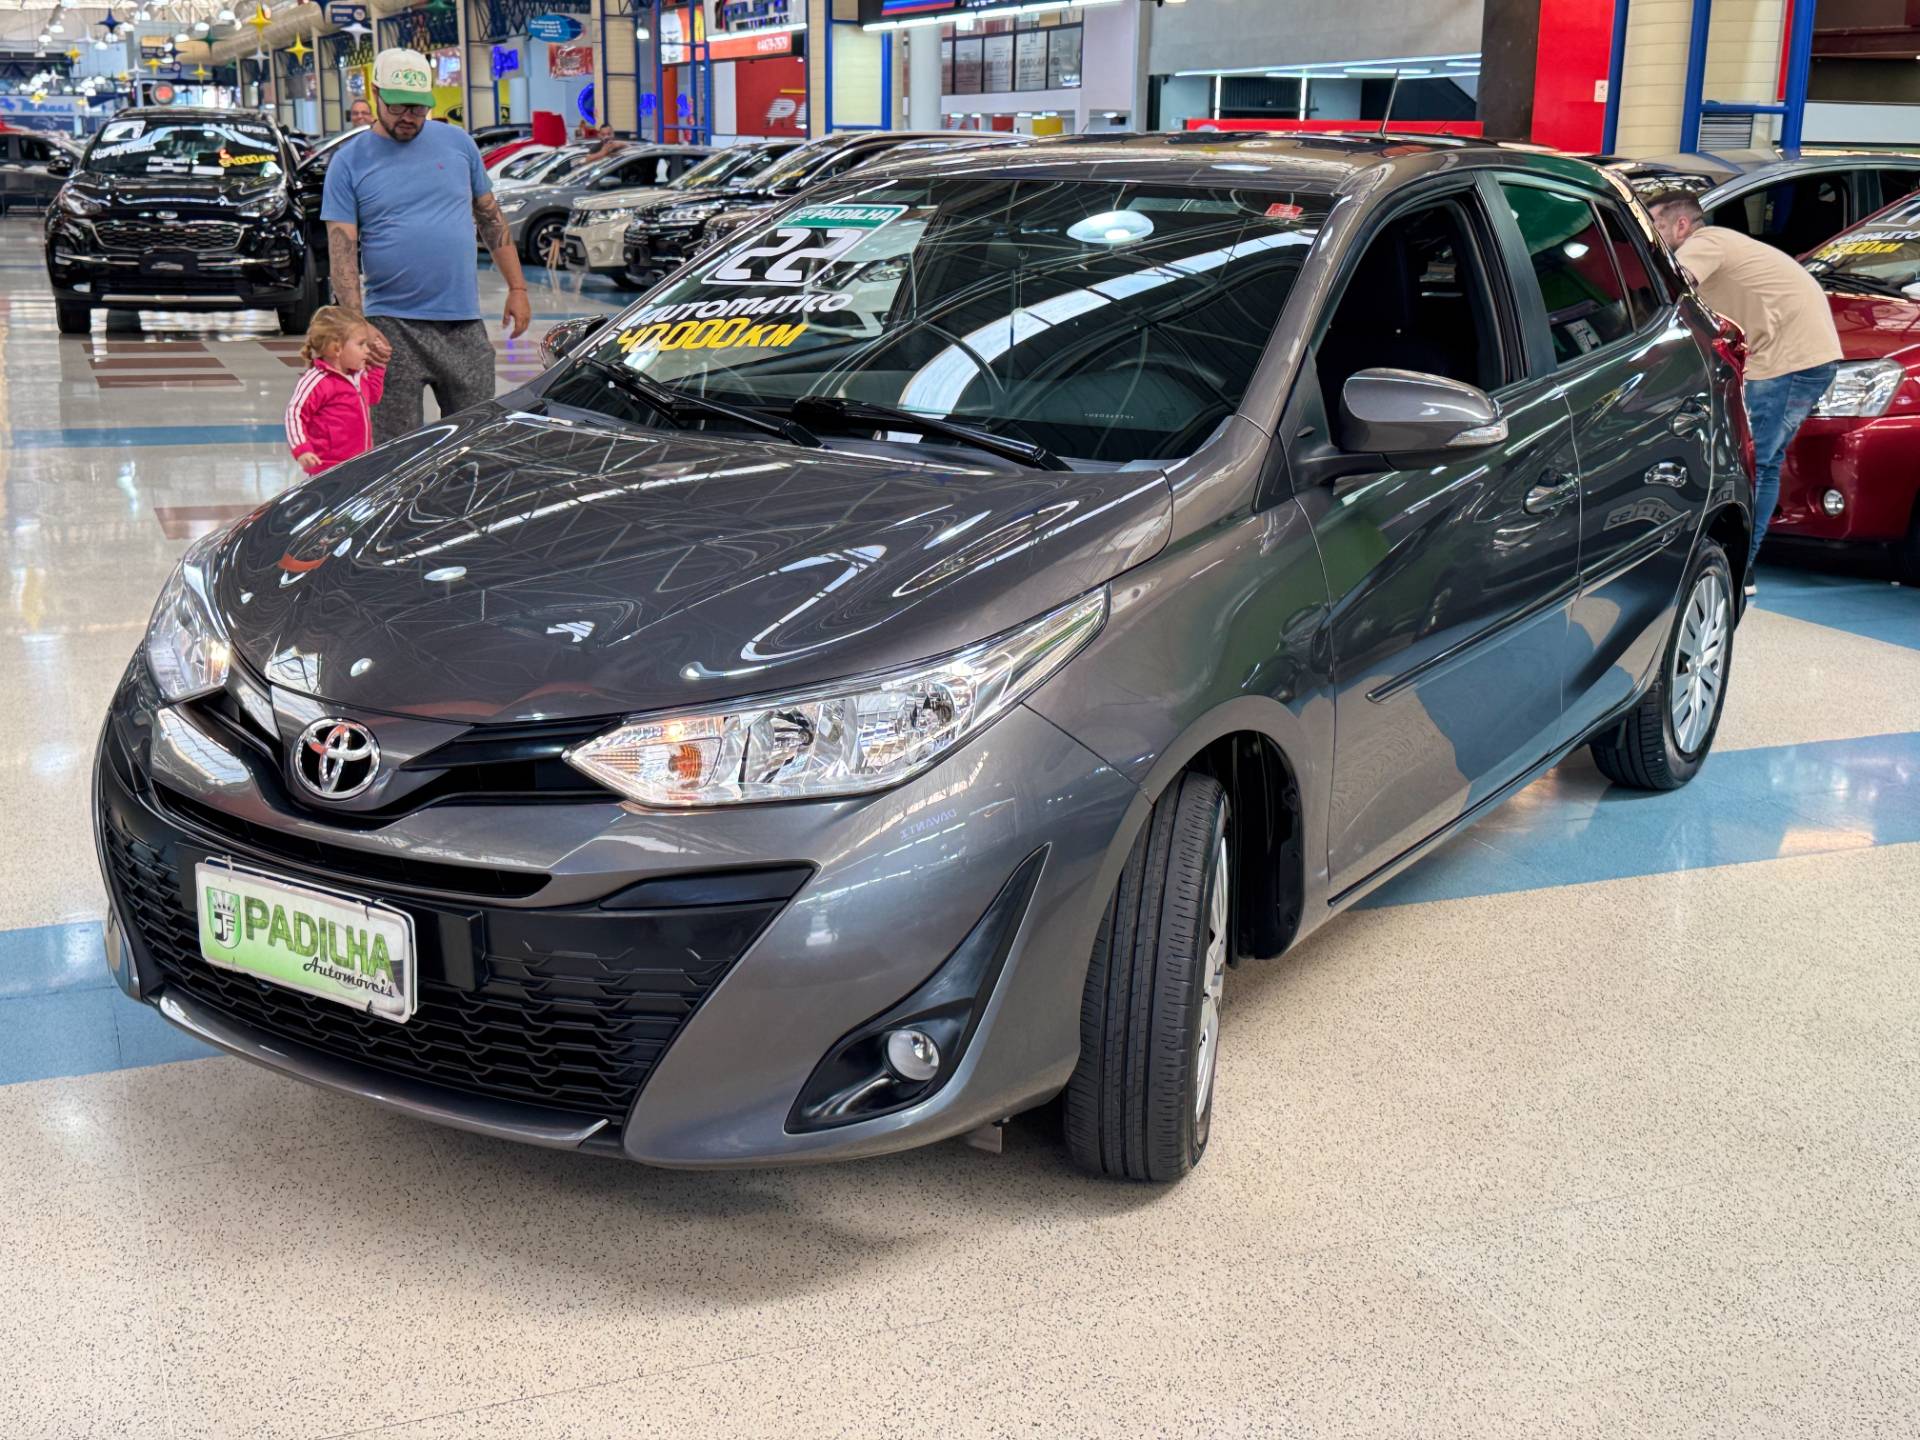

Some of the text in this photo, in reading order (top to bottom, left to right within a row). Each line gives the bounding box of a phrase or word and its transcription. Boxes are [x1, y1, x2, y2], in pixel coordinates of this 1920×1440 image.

[808, 208, 895, 220] PADILHA
[715, 229, 864, 282] 22
[617, 293, 853, 329] AUTOMATICO
[244, 896, 395, 983] PADILHA
